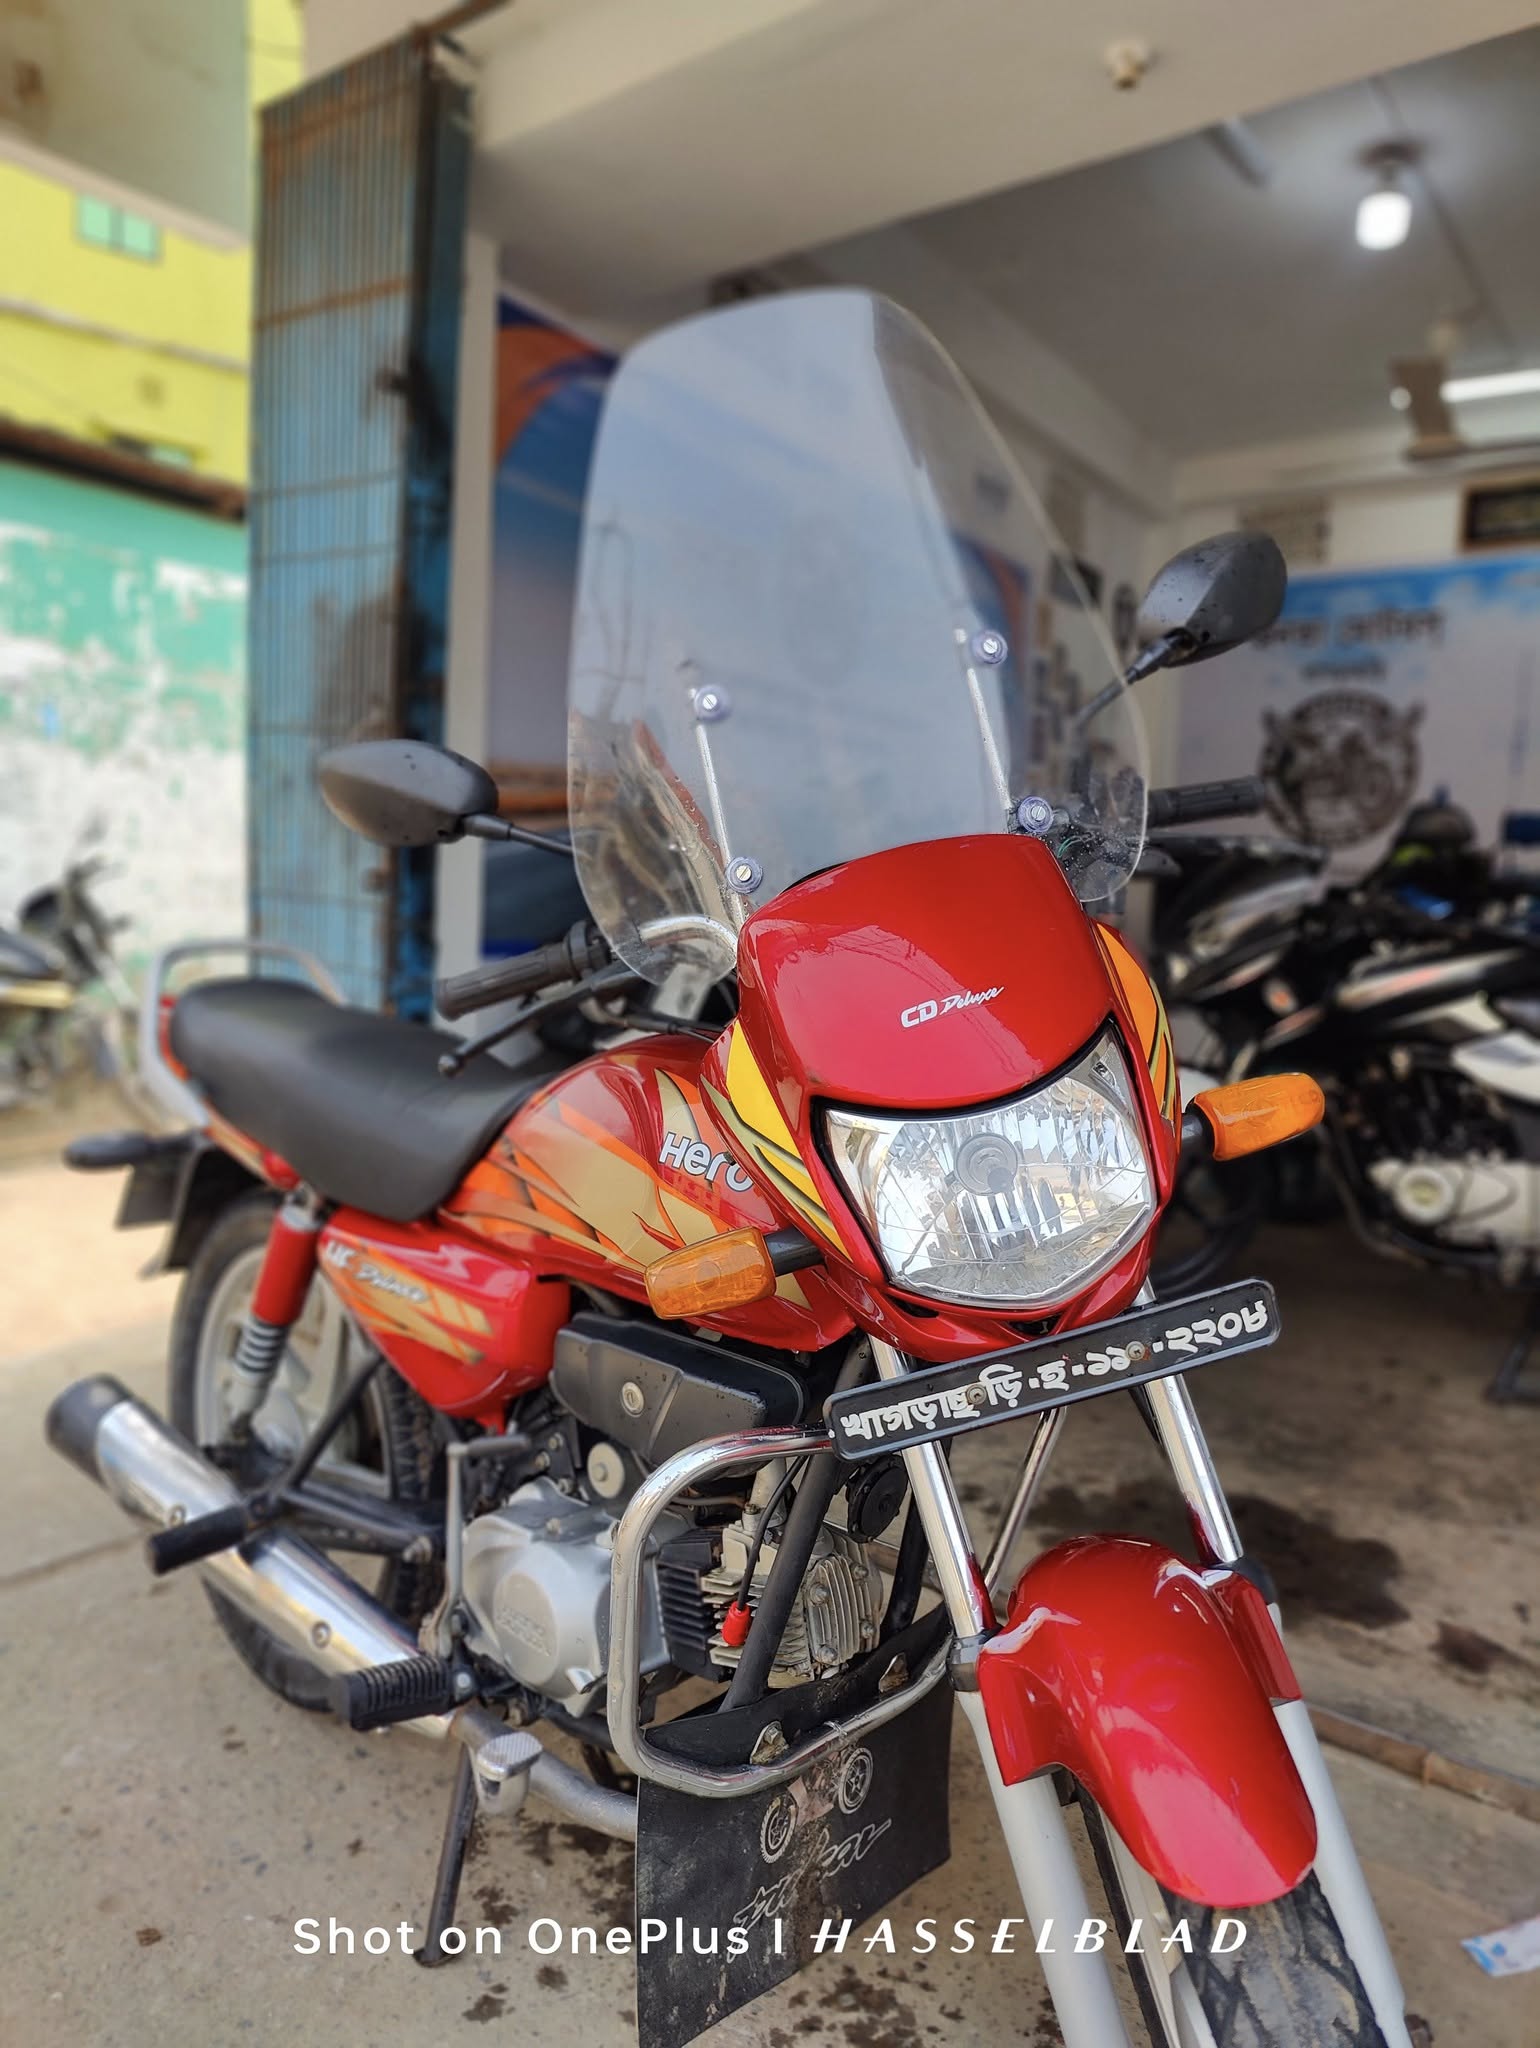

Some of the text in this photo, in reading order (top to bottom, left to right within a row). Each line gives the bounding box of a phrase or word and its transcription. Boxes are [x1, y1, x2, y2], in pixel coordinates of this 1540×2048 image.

[900, 986, 1005, 1028] CD Deluxe
[658, 1131, 754, 1193] Hero
